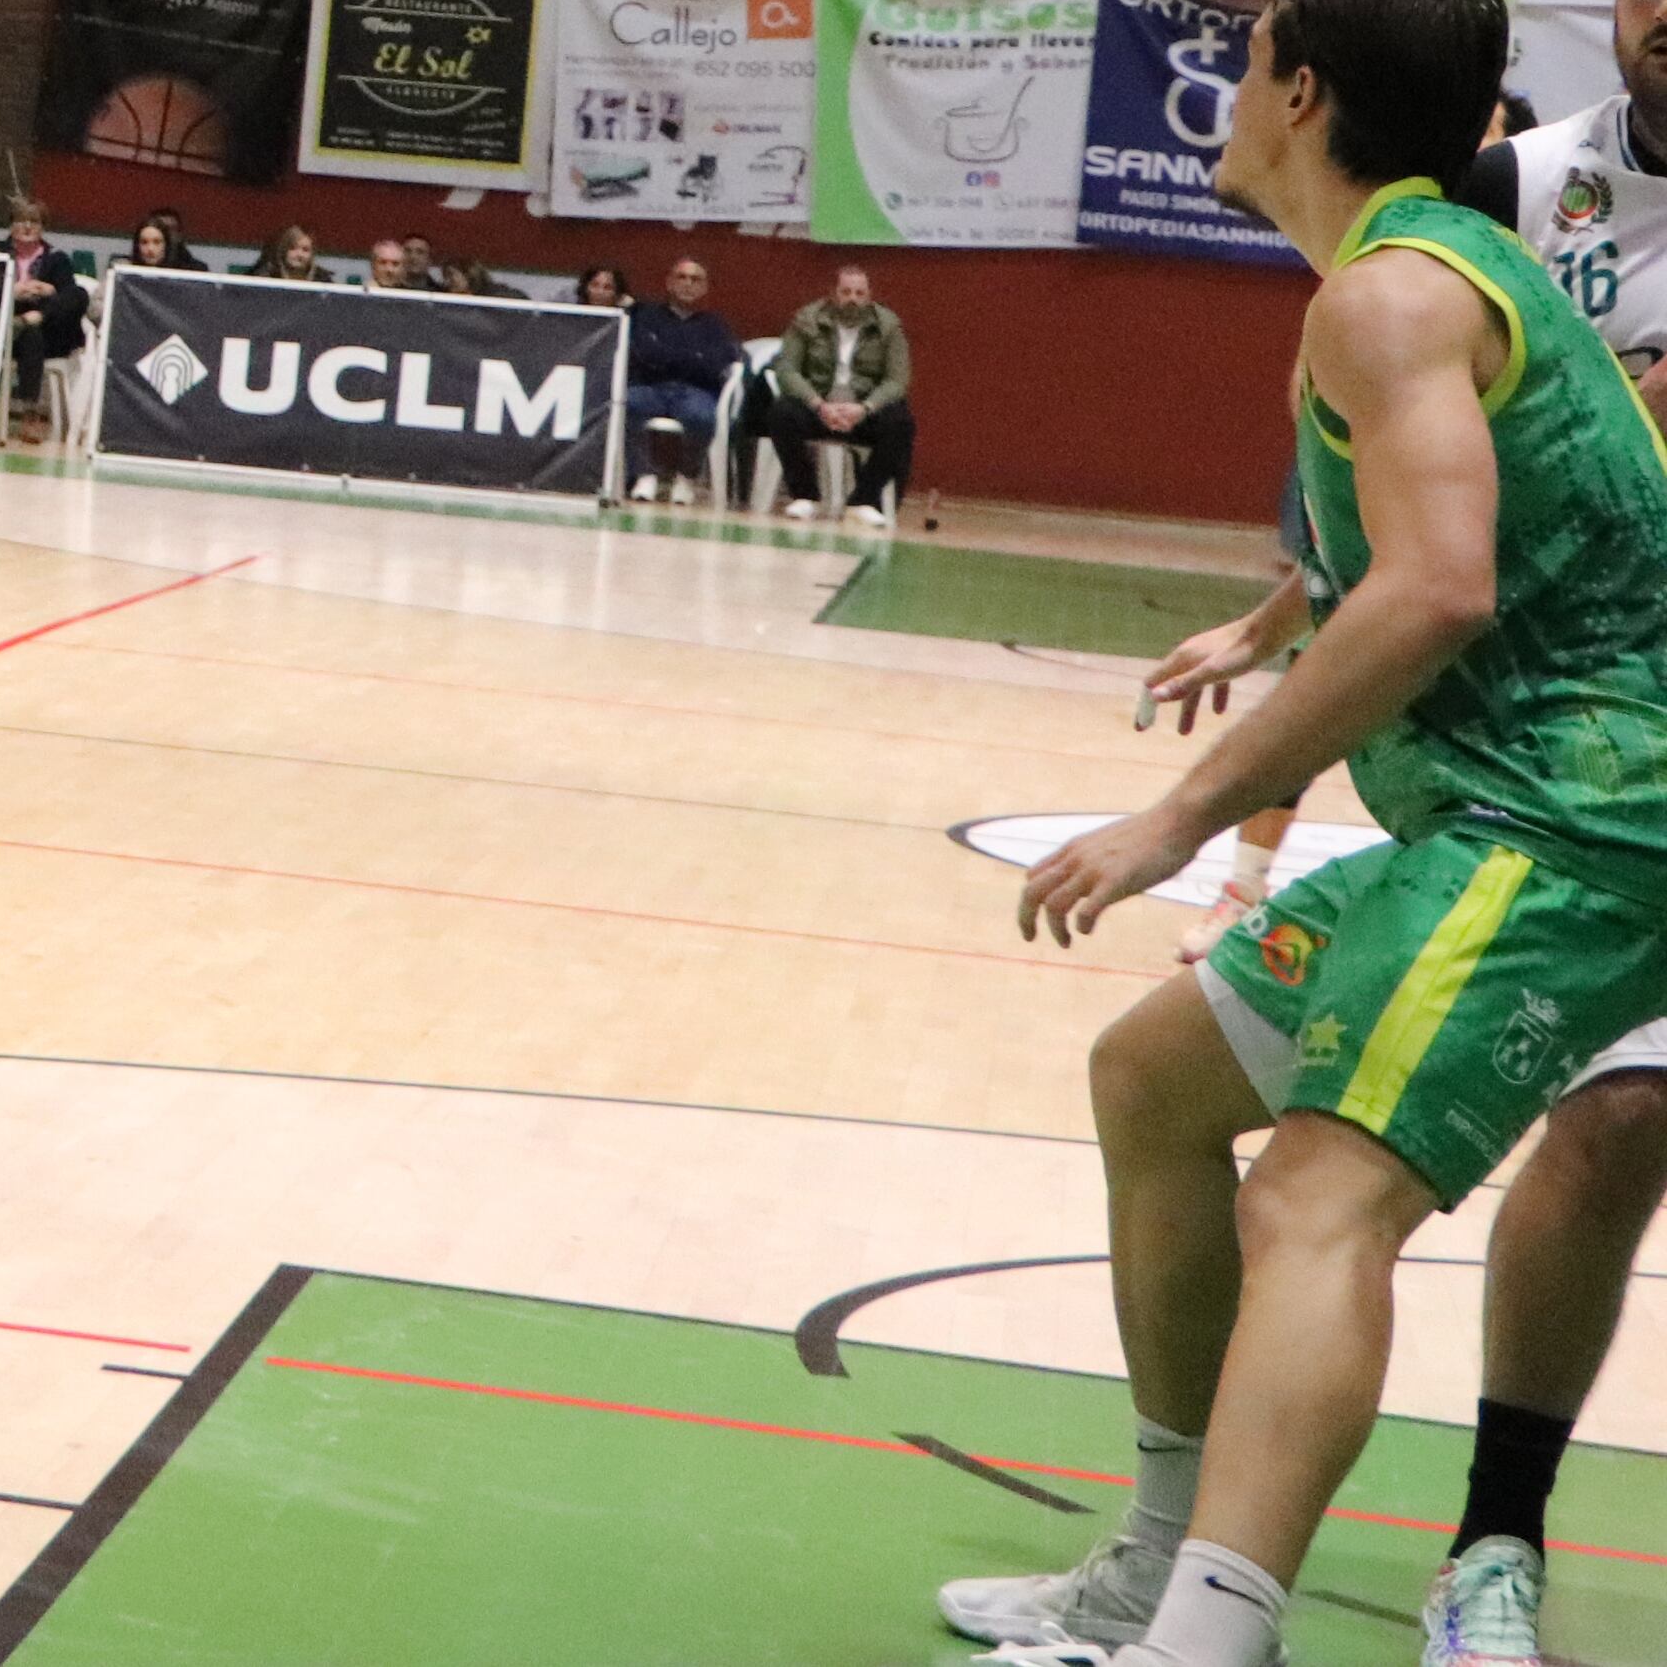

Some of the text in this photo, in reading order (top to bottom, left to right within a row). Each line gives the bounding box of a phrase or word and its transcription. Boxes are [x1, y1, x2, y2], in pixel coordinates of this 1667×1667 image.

[610, 1, 738, 54] Callejo
[869, 32, 960, 49] Comidas
[971, 35, 1019, 53] para
[374, 42, 474, 80] El Sol
[1120, 189, 1168, 209] PASEO
[219, 337, 585, 442] UCLM
